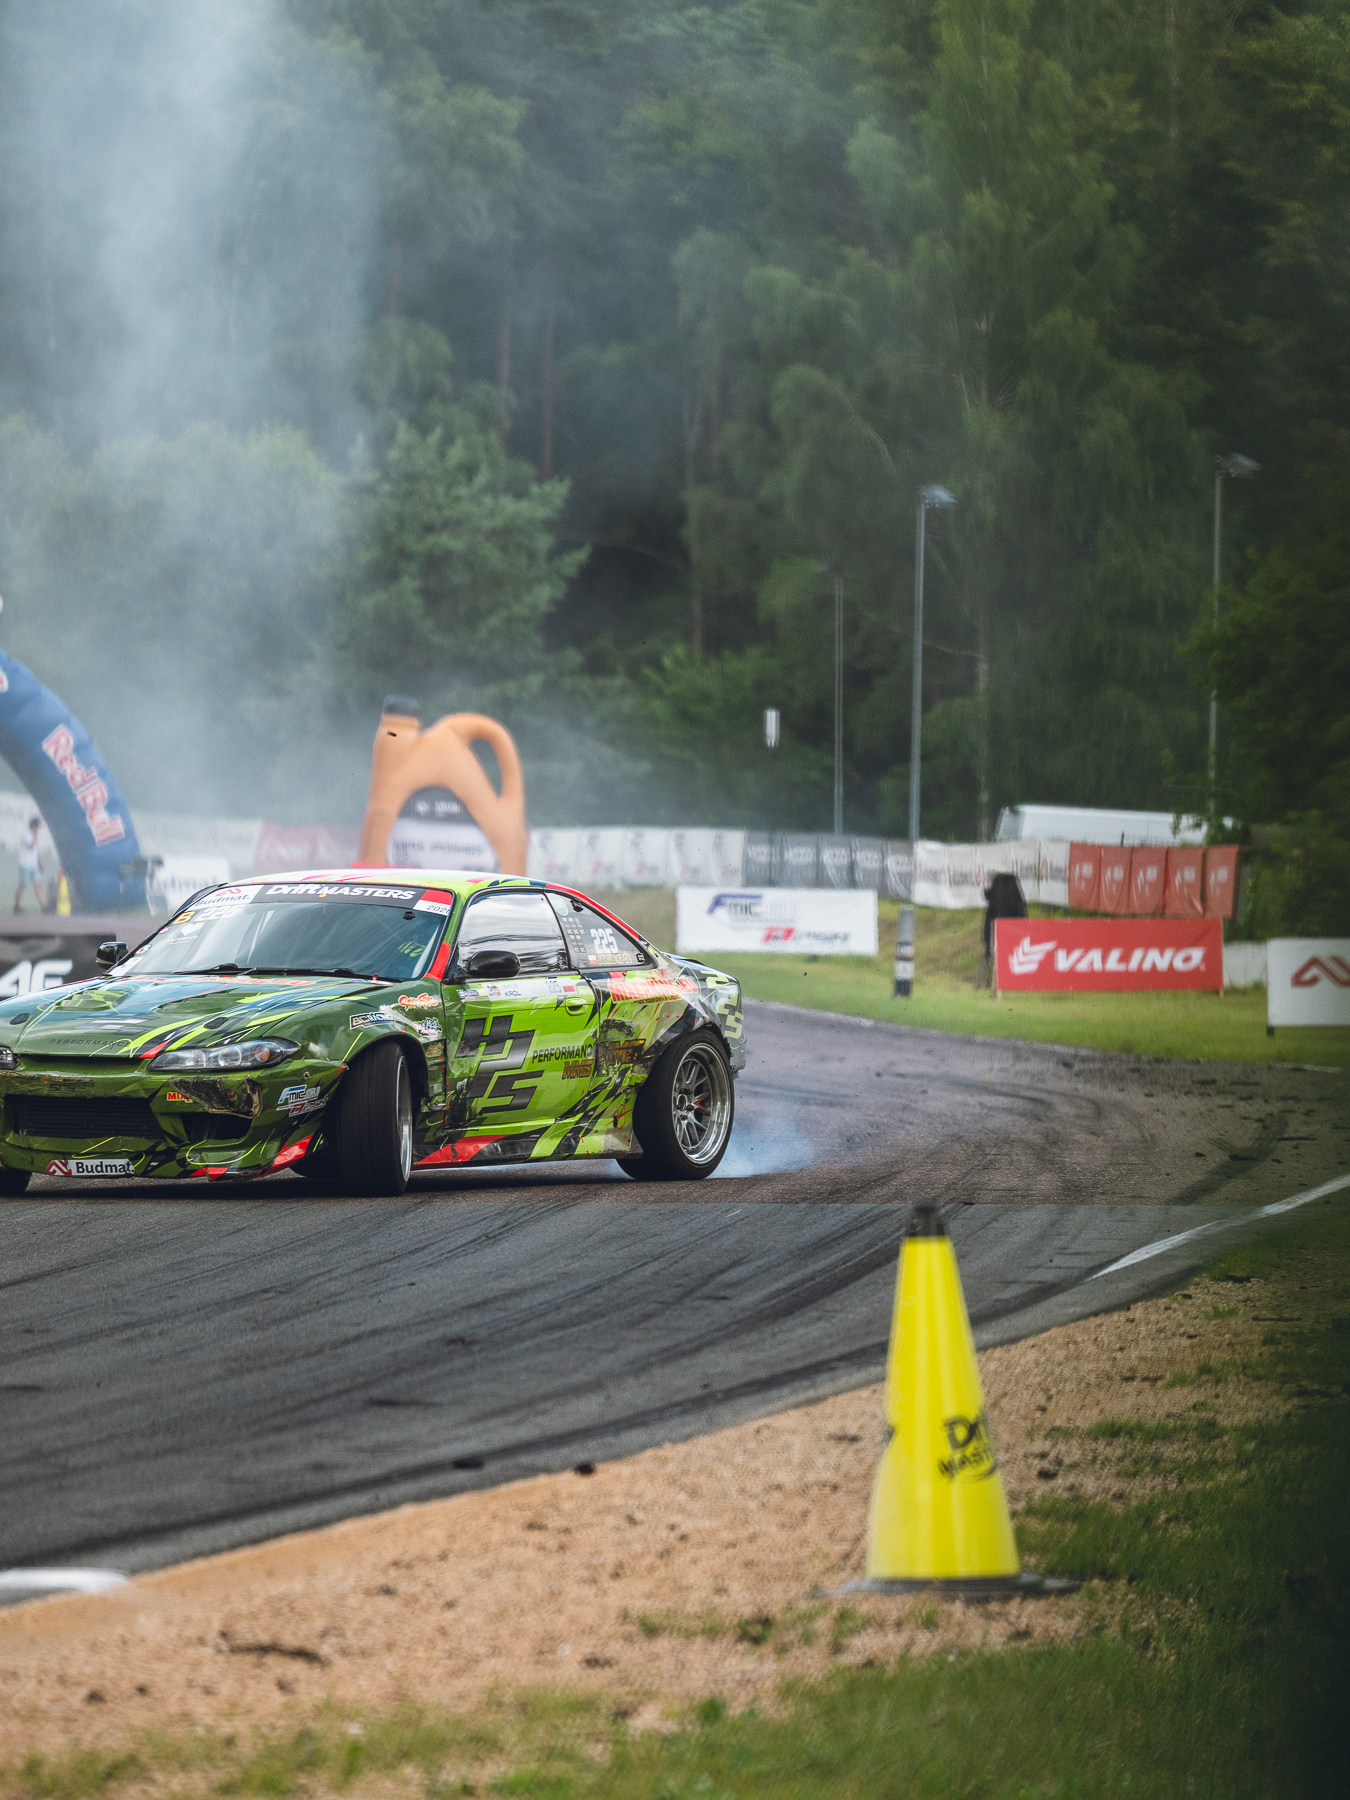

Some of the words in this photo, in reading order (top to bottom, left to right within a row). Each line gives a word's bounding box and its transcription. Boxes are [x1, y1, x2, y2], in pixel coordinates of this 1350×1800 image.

[171, 910, 195, 925] B
[194, 905, 242, 921] 225
[590, 928, 619, 954] 225
[1055, 947, 1206, 972] VALINO
